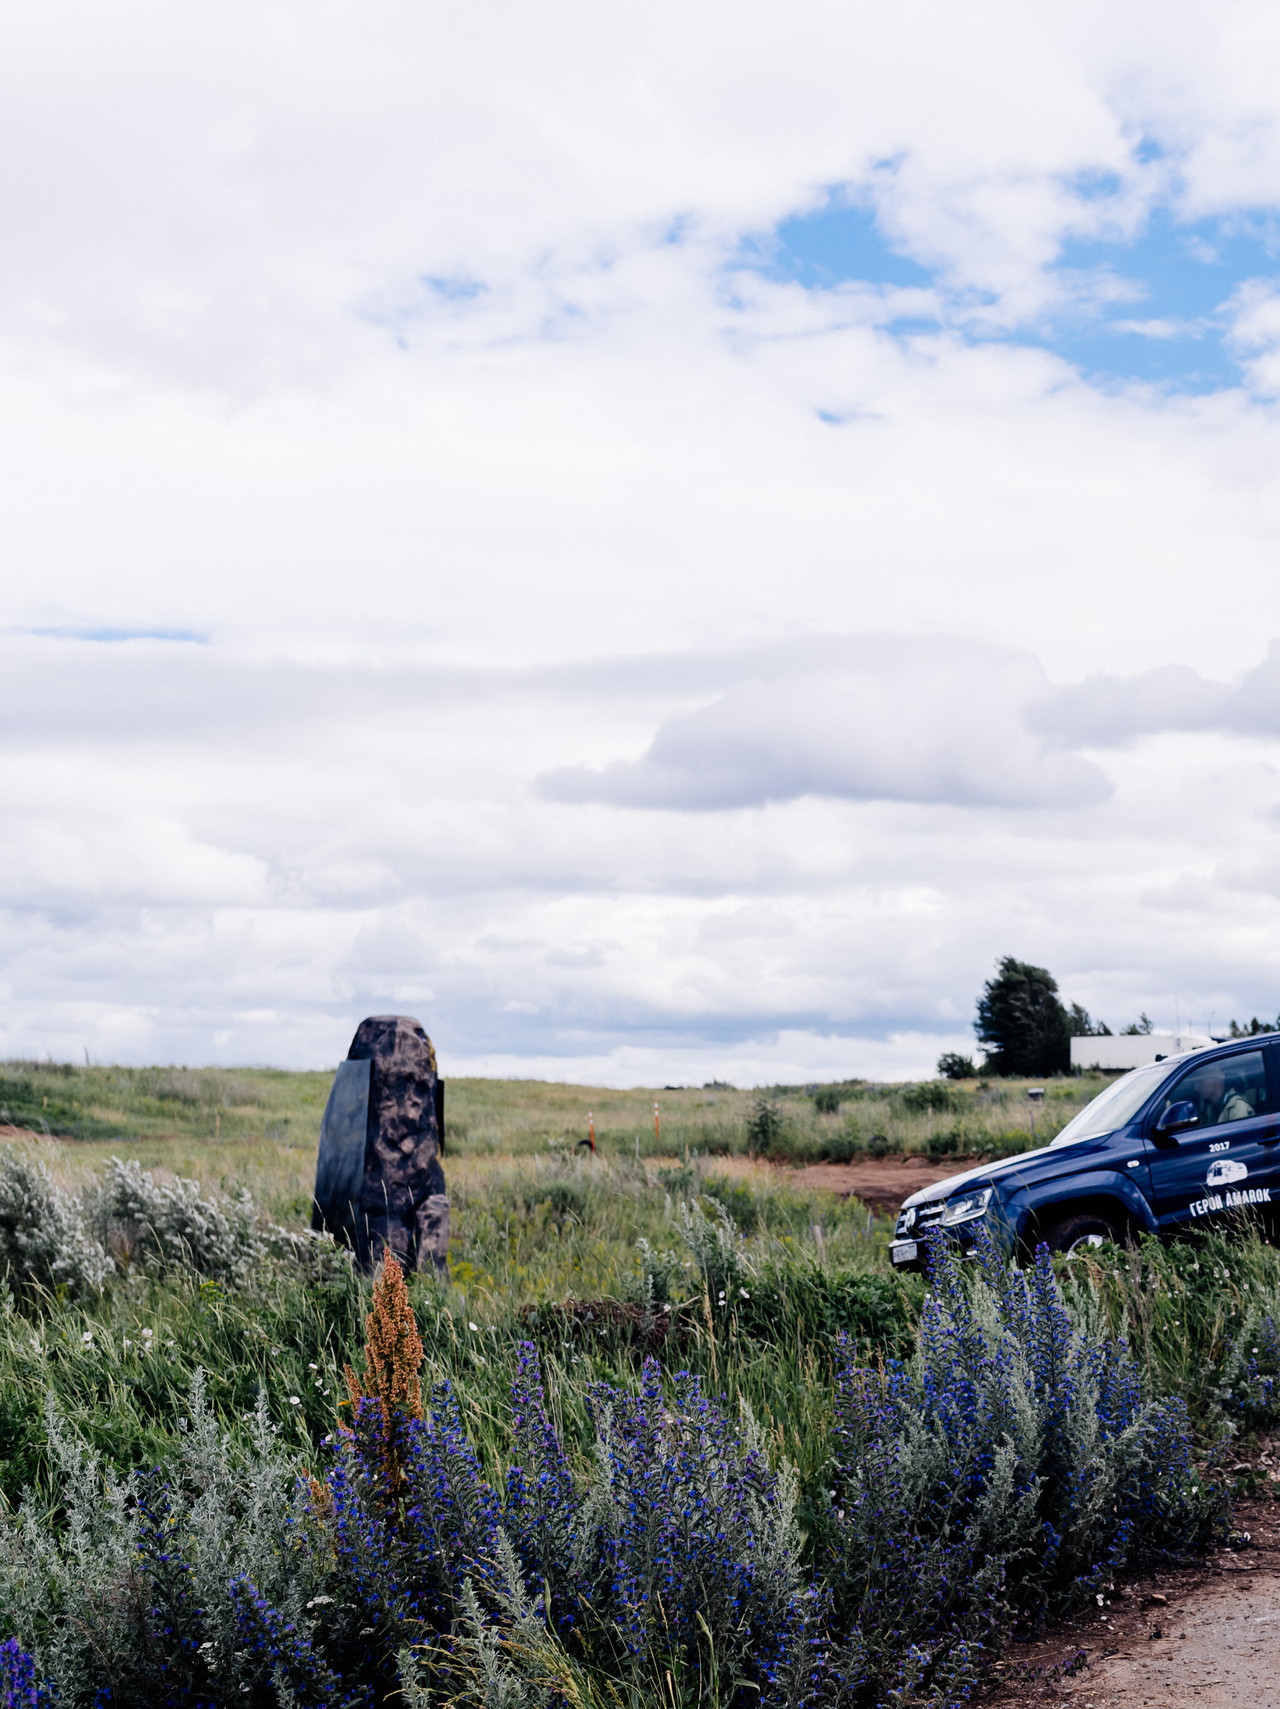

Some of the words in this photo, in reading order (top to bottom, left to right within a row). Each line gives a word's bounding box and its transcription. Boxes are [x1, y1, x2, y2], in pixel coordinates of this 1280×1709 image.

[1208, 1141, 1230, 1153] 2017
[1189, 1193, 1223, 1217] ГЕРОЙ
[1225, 1188, 1272, 1207] AMAROK
